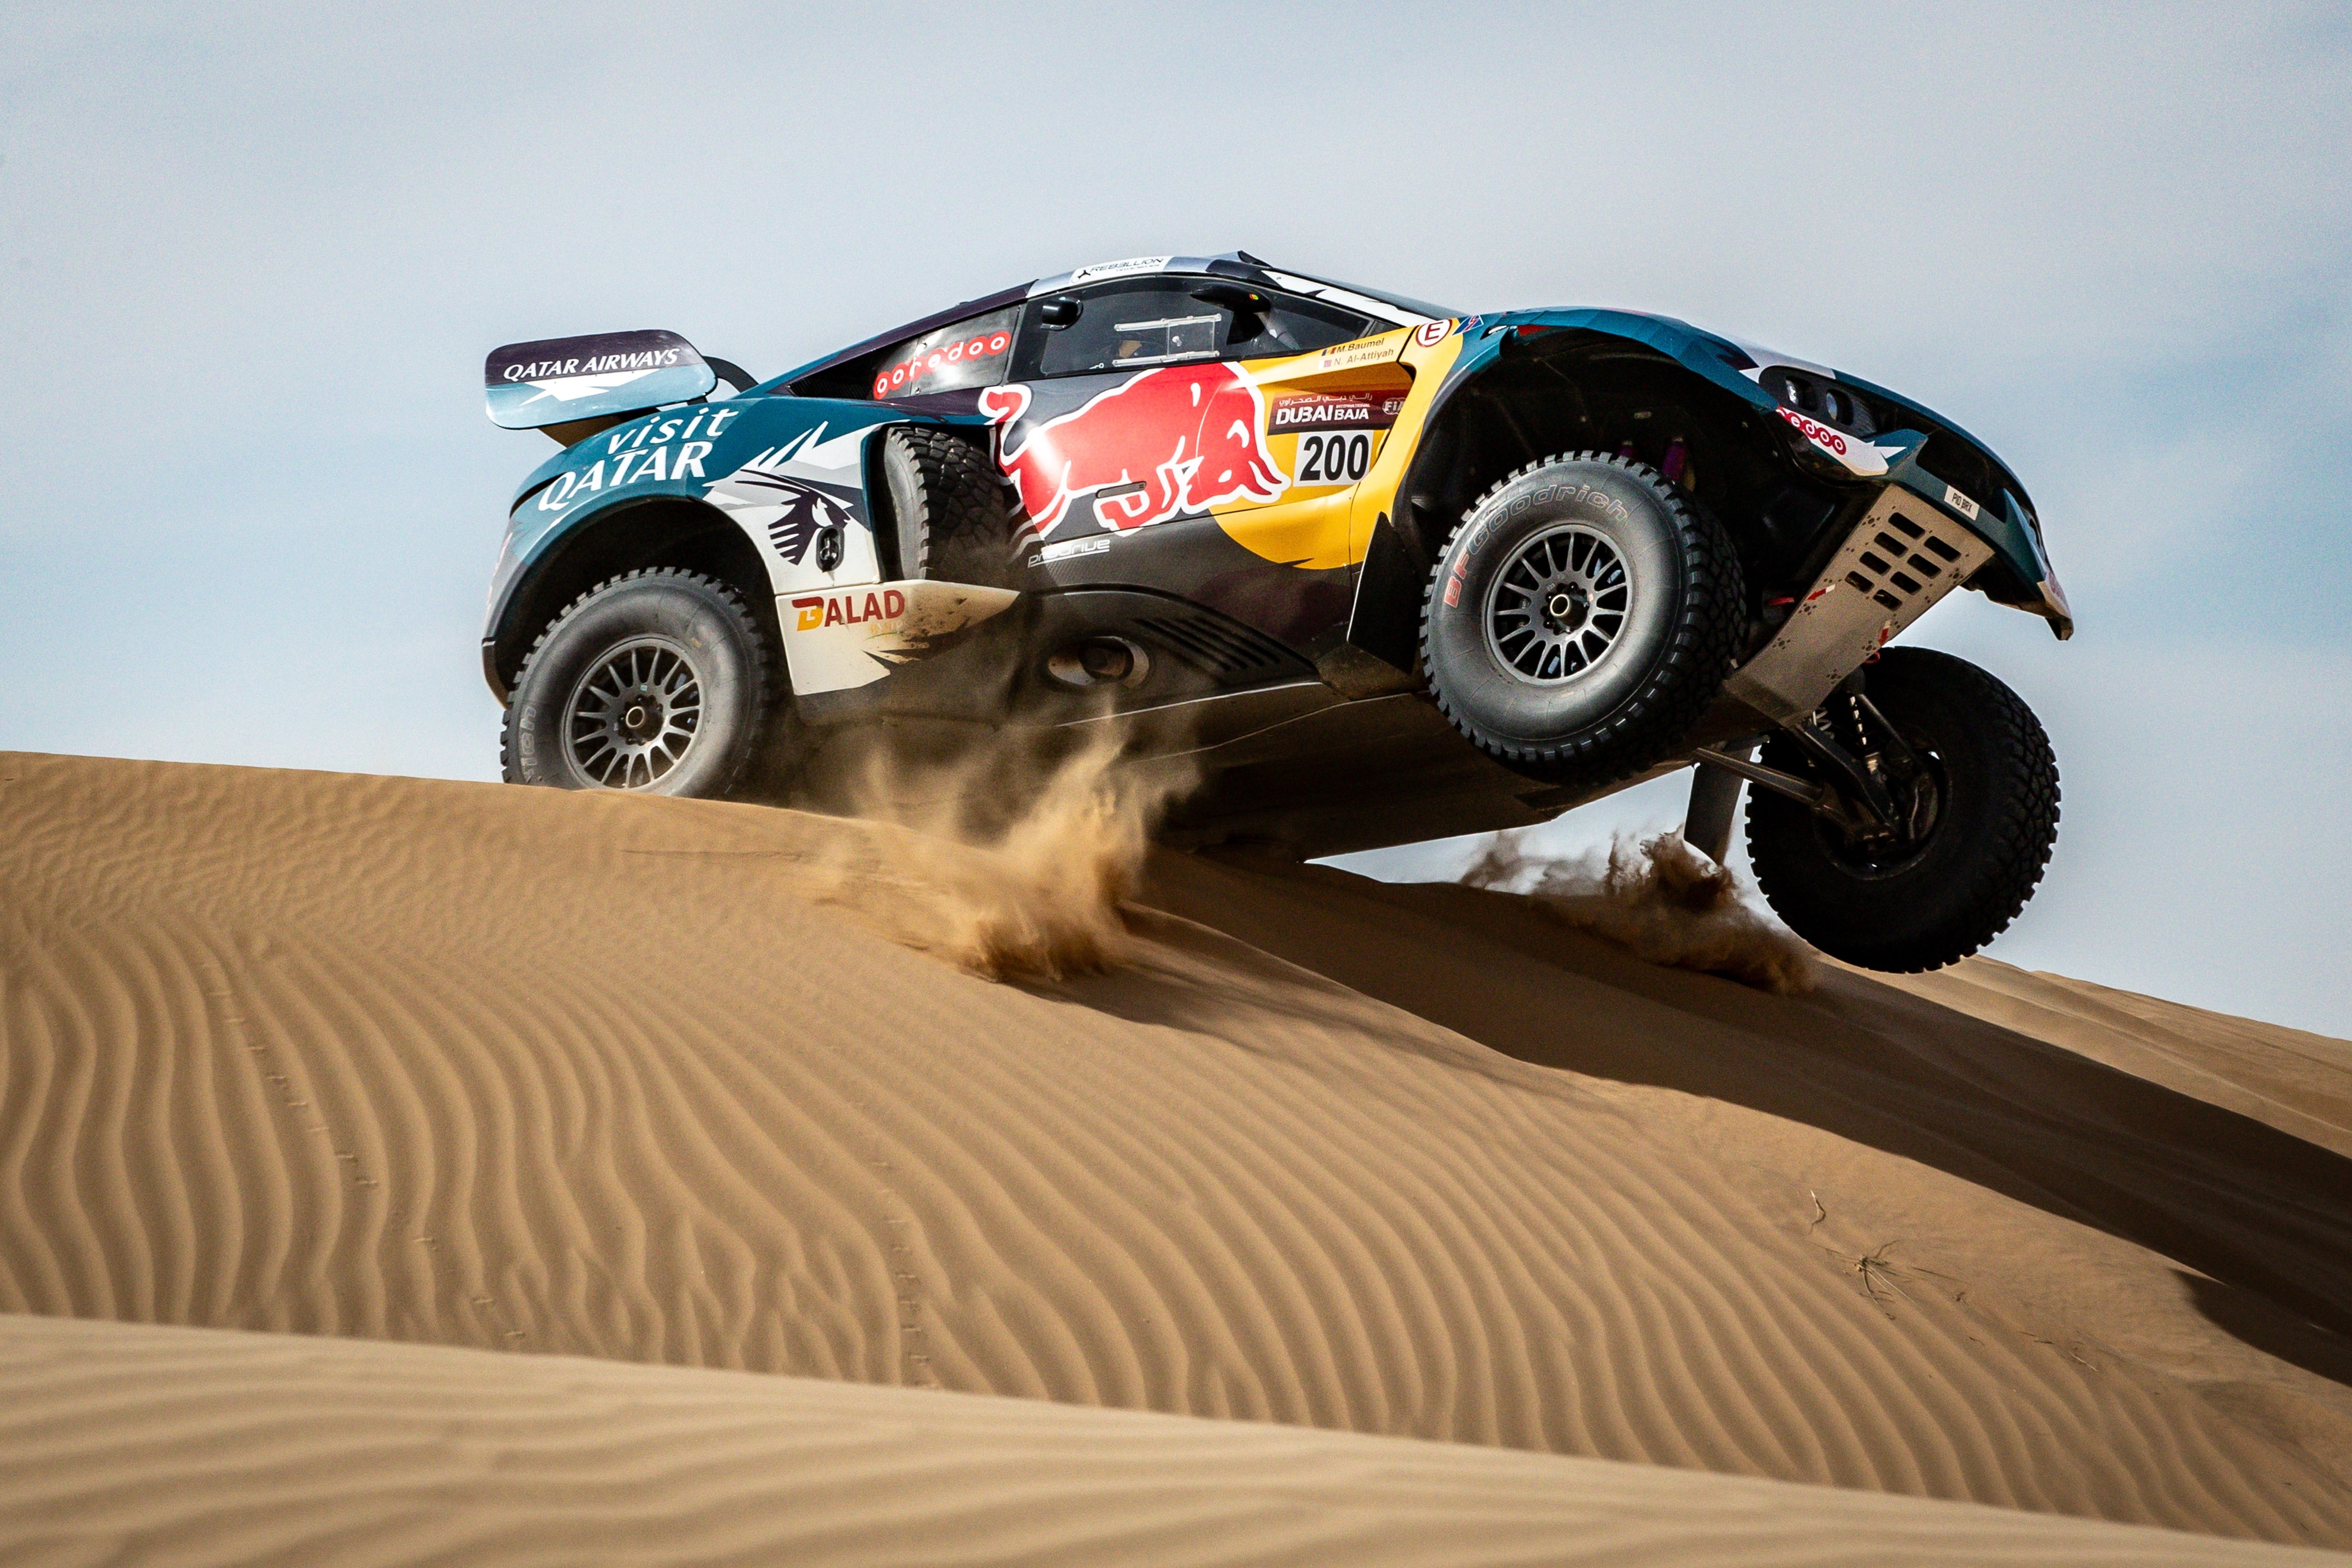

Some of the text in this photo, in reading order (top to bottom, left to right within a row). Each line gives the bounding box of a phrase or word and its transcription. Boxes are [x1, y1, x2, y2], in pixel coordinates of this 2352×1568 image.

[1336, 338, 1384, 353] M.Baumel
[1425, 321, 1443, 341] E
[503, 348, 680, 382] QATAR AIRWAYS
[876, 336, 1006, 393] ooredoo
[1346, 348, 1394, 364] Al-Attiyah
[1275, 405, 1369, 425] DUBAI BAJA
[1300, 435, 1369, 481] 200
[538, 441, 713, 511] QATAR
[1027, 539, 1110, 569] prodrive
[1444, 485, 1629, 608] BFGoodrich
[792, 589, 905, 631] BALAD
